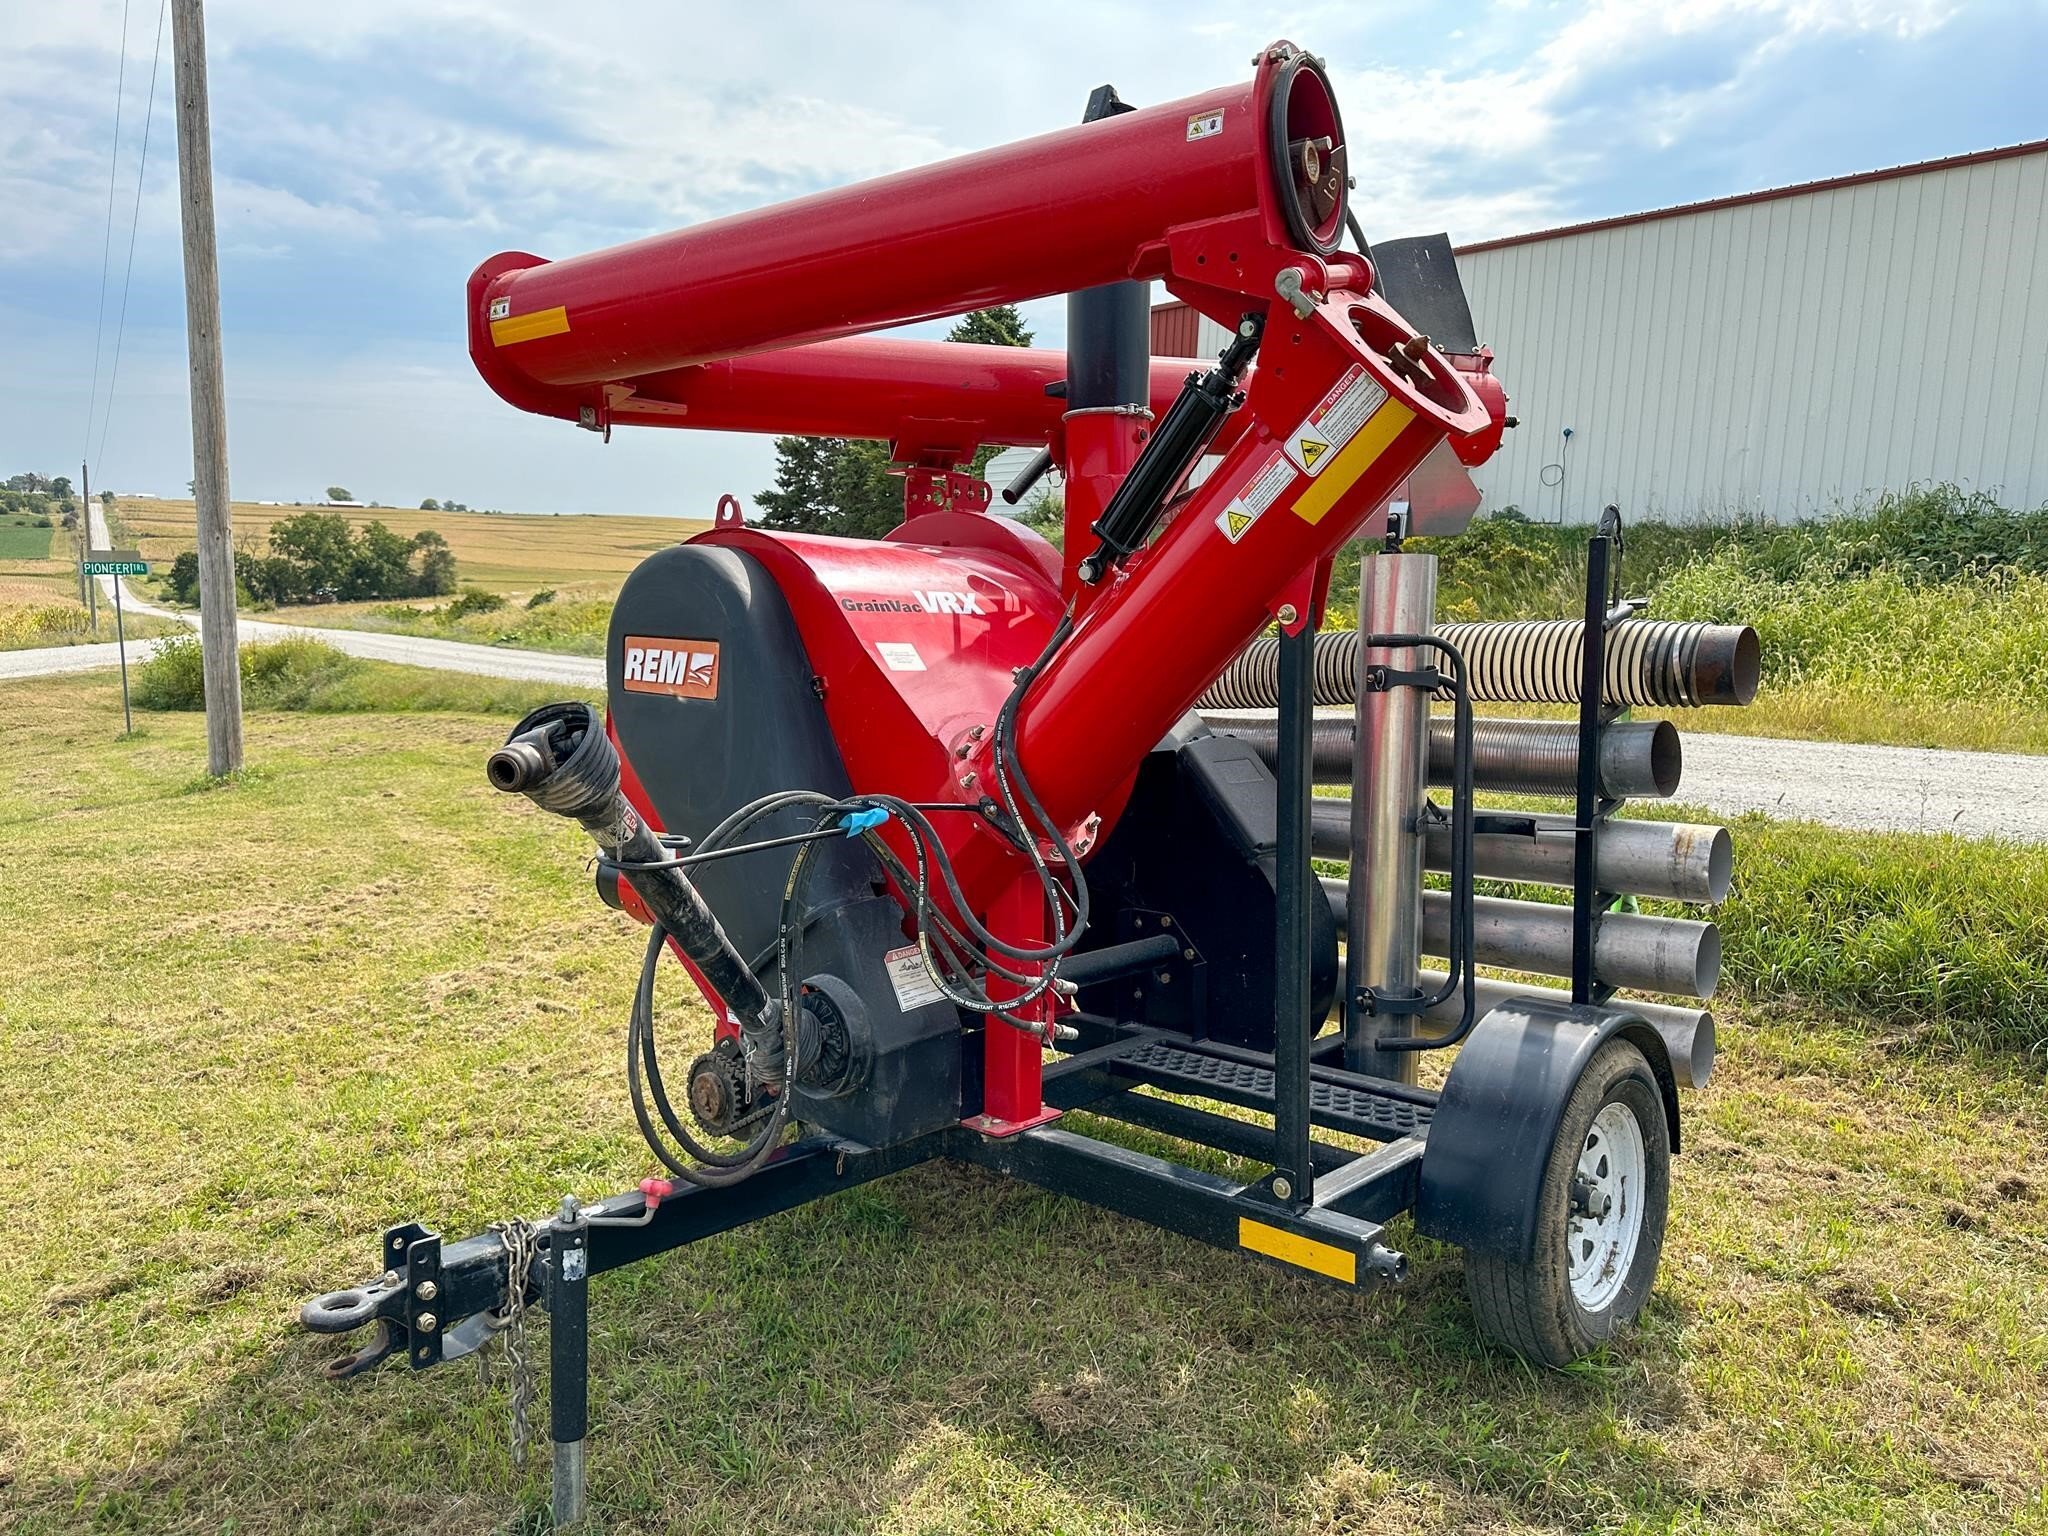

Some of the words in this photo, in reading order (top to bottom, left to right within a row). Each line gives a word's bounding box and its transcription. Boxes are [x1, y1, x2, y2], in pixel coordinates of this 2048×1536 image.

[1326, 373, 1356, 405] DANGER
[1253, 463, 1271, 485] DANGER
[84, 563, 130, 574] PIONEER
[133, 563, 145, 572] TRL
[841, 598, 922, 613] GrainVac
[912, 590, 987, 615] VRX
[624, 647, 689, 685] REM
[941, 986, 965, 1005] ABRASION
[964, 1000, 994, 1011] RESISTANT
